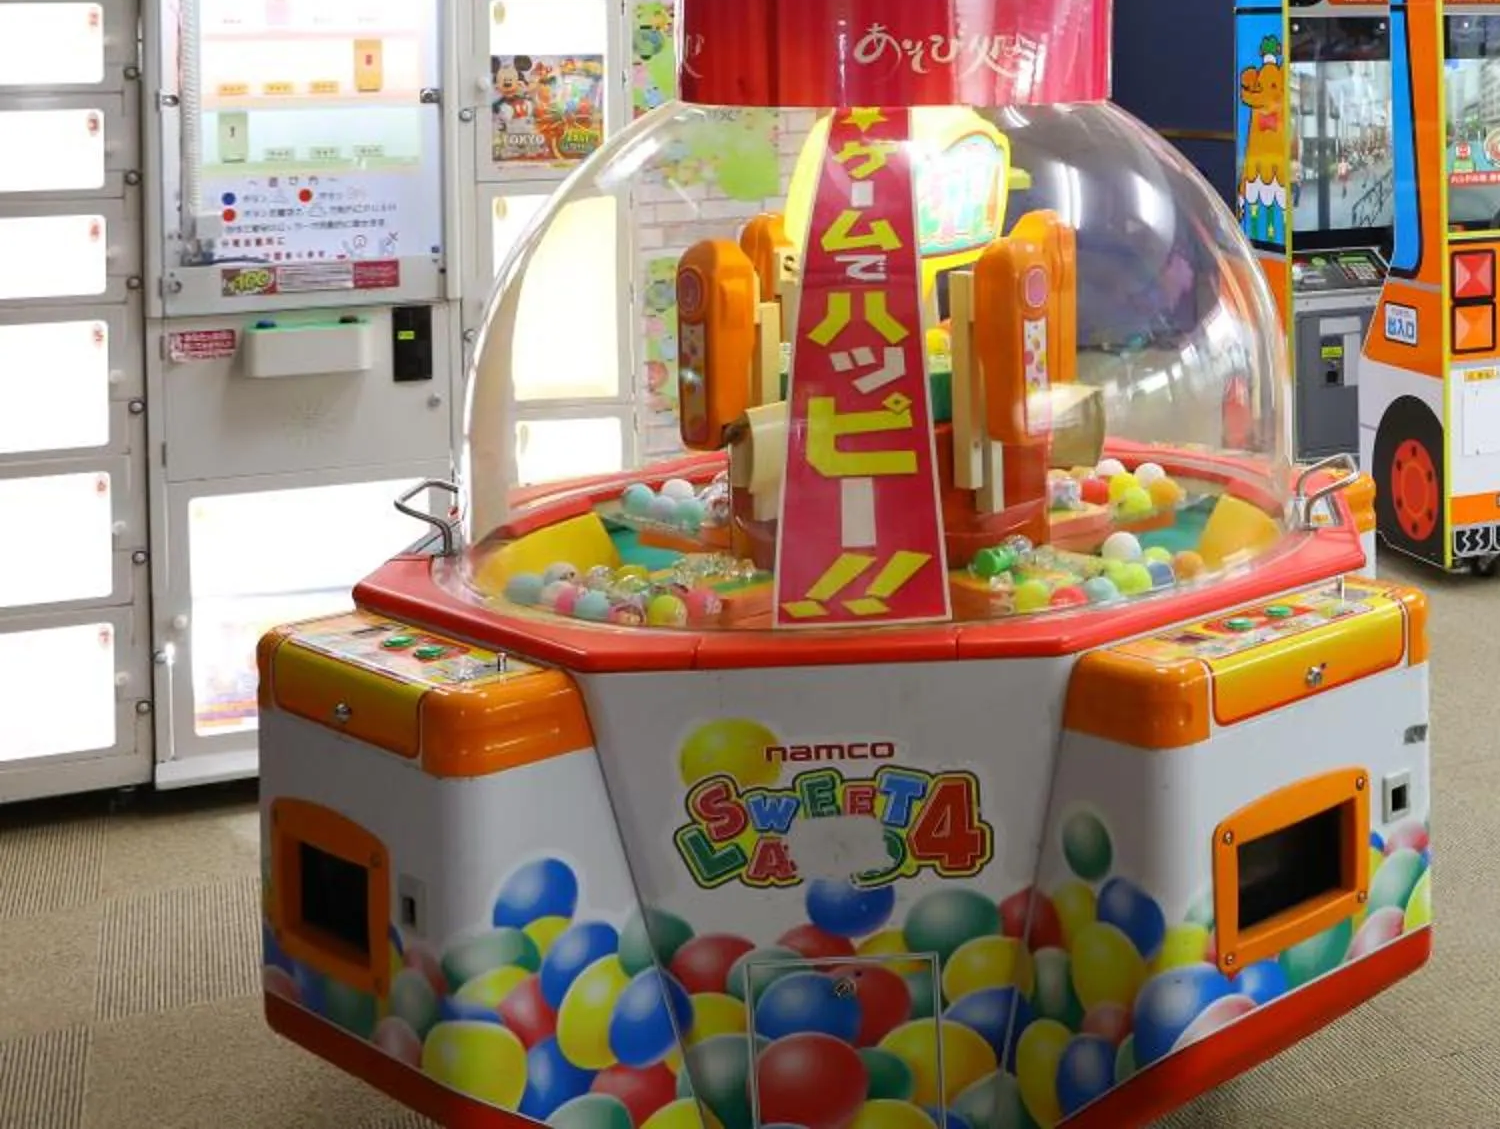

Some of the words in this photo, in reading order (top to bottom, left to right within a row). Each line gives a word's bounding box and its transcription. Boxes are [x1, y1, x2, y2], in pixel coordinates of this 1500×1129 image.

[765, 742, 895, 762] namco
[695, 773, 929, 842] SWEET
[908, 776, 982, 872] 4
